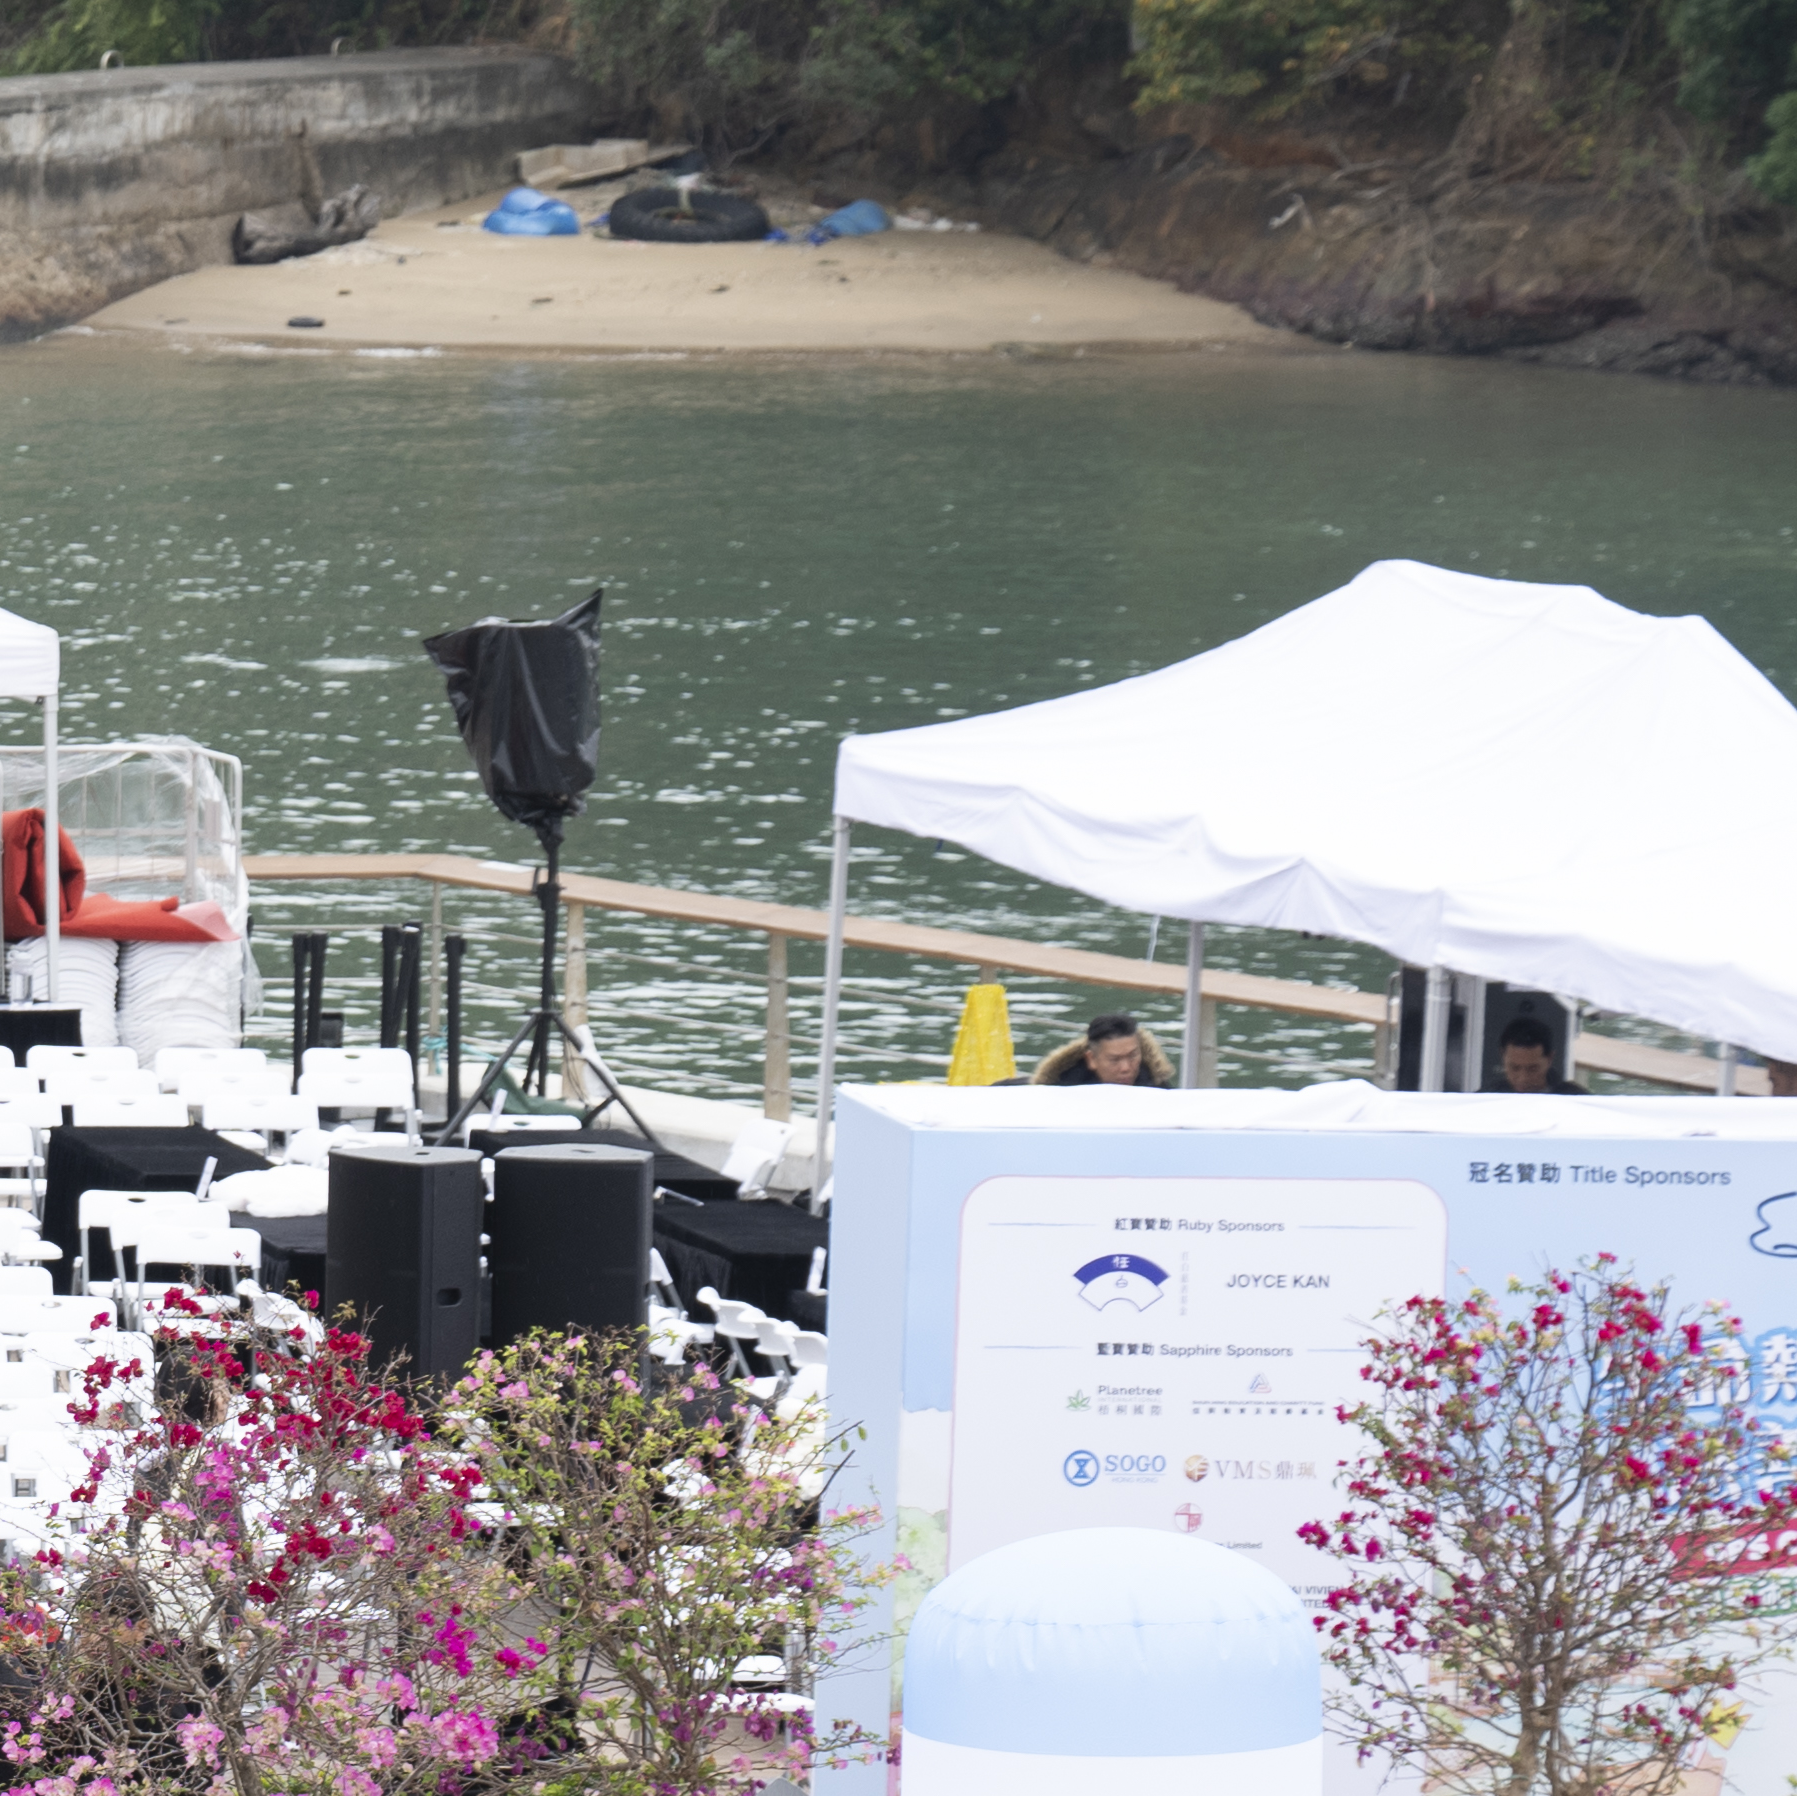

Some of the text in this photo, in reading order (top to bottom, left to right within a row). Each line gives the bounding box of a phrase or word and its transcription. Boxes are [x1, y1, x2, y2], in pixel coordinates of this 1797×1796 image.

[1570, 1164, 1618, 1184] Title
[1624, 1165, 1733, 1187] Sponsors
[1178, 1219, 1213, 1234] Ruby
[1218, 1220, 1286, 1233] Sponsors
[1227, 1274, 1330, 1289] JOYCE KAN
[1160, 1343, 1223, 1359] Sapphire
[1227, 1344, 1294, 1358] Sponsors
[1098, 1384, 1163, 1397] Planetree
[1105, 1455, 1167, 1473] SOGO
